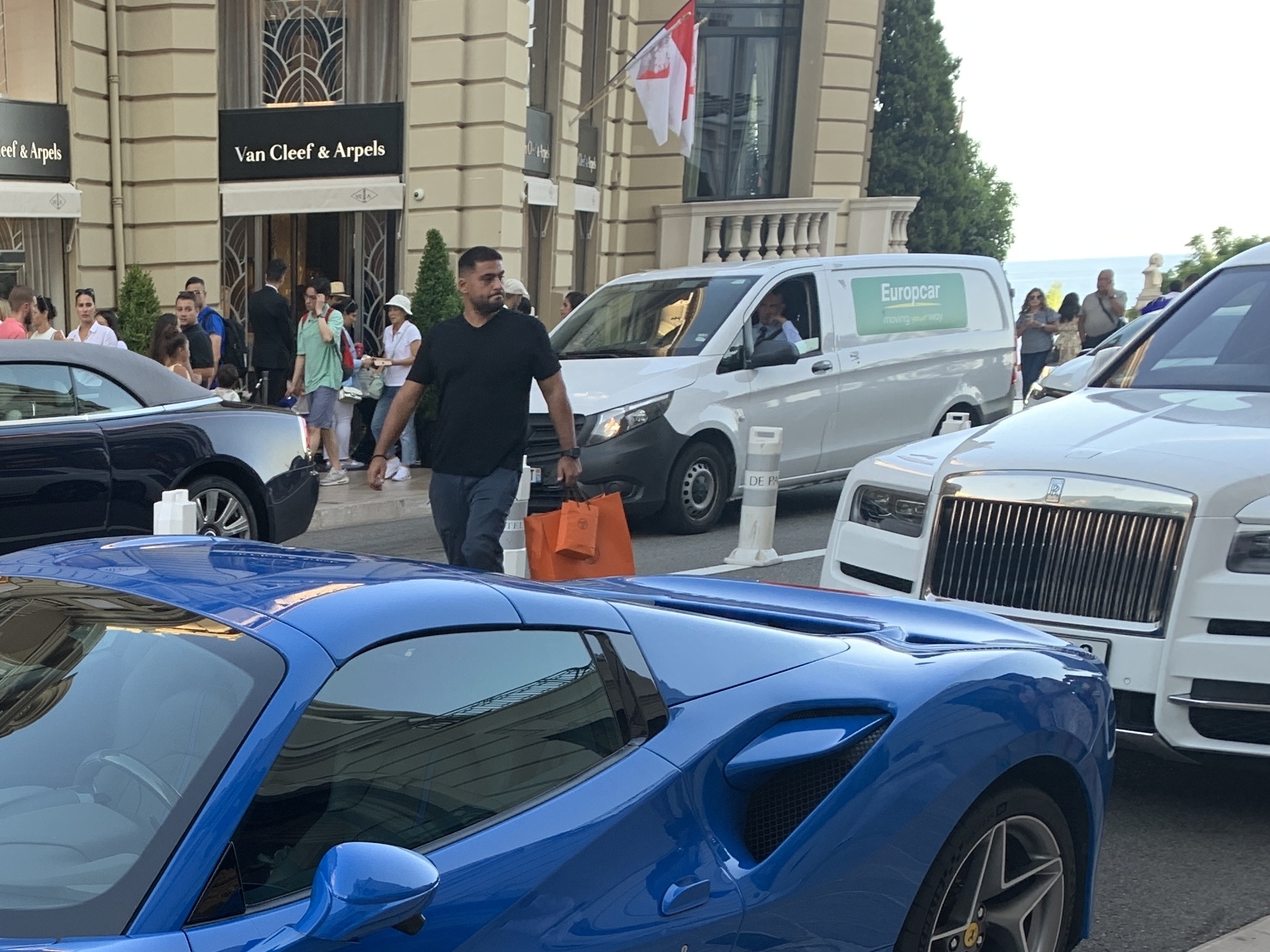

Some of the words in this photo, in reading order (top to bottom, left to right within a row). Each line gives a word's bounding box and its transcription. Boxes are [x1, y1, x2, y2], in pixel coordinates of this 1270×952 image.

[20, 144, 28, 158] &
[30, 142, 62, 165] Arpels
[234, 146, 266, 162] Van
[270, 143, 315, 161] Cleef
[318, 145, 330, 159] &
[334, 140, 386, 162] Arpels
[881, 283, 940, 307] Europcar
[883, 314, 909, 325] moving
[749, 475, 764, 487] DE
